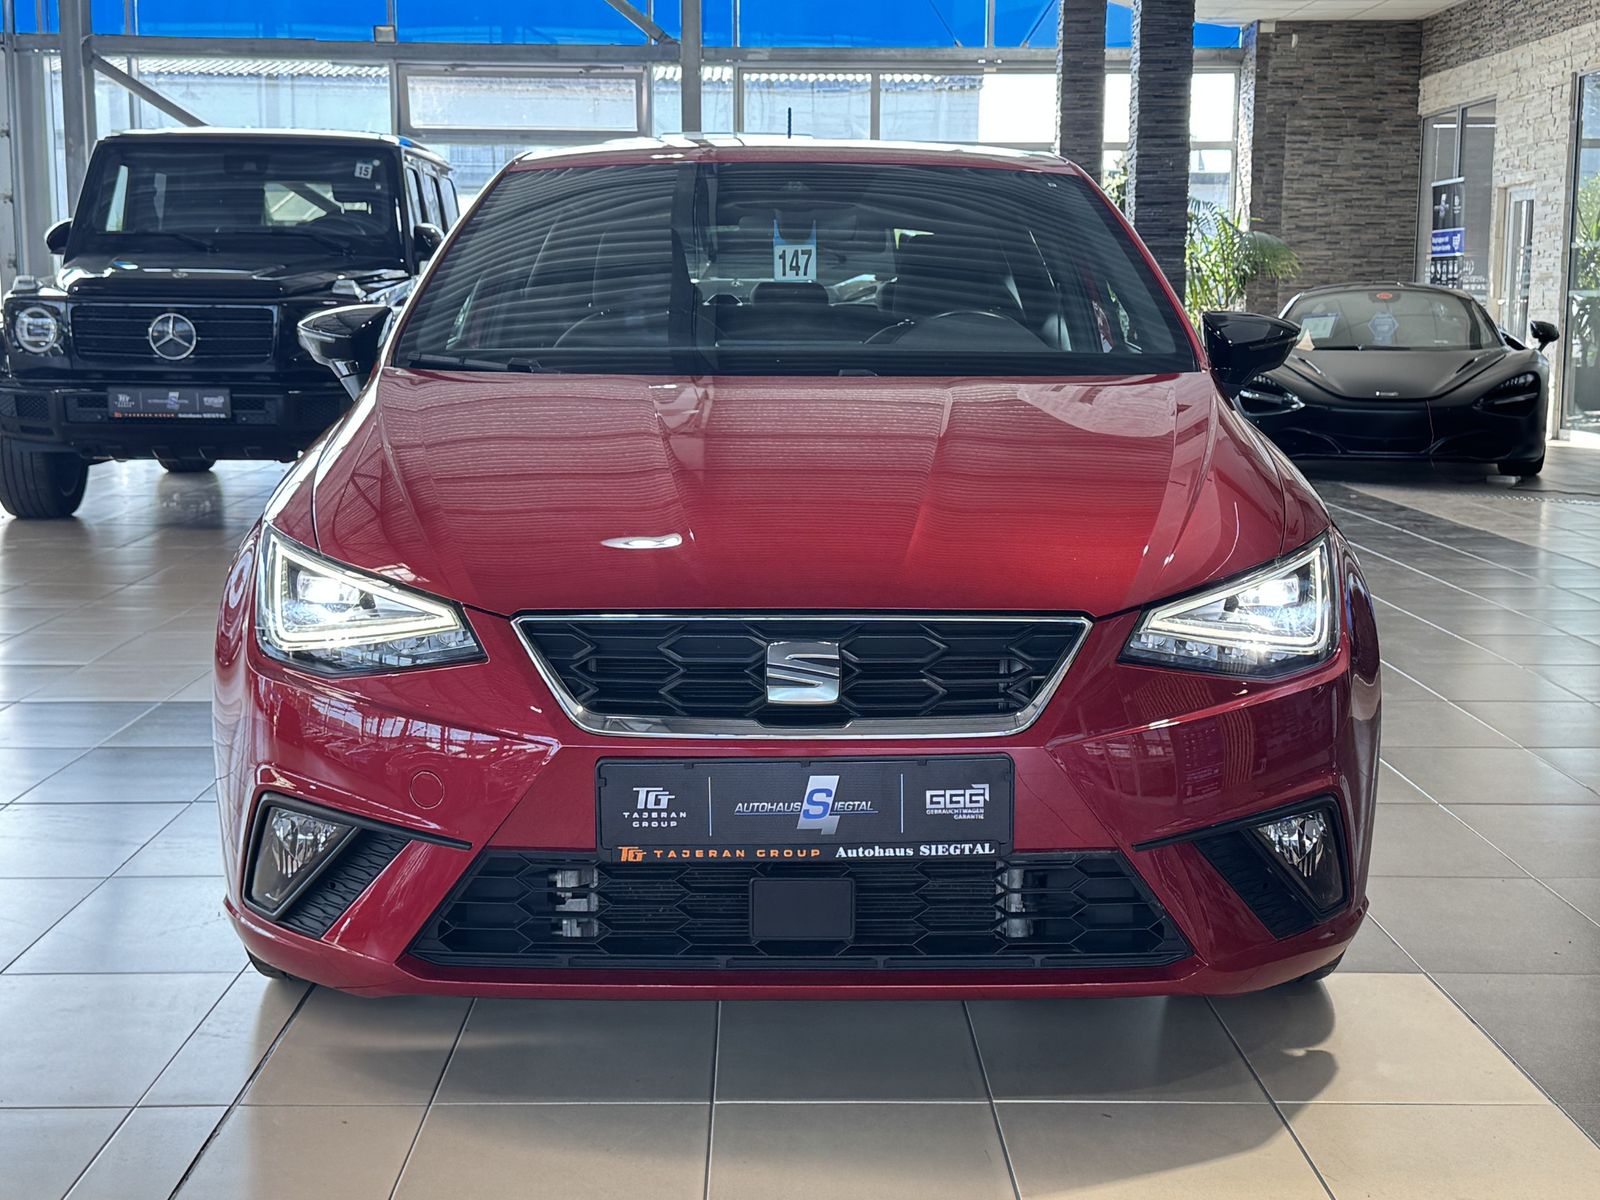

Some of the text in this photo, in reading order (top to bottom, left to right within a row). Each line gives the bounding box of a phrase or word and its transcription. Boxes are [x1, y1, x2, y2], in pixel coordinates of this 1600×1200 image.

[779, 249, 812, 277] 147
[734, 801, 801, 813] AUTOHAUS
[926, 789, 985, 809] GGG
[653, 849, 746, 859] TAJERAN
[756, 849, 821, 858] GROUP
[835, 846, 914, 858] Autohaus
[919, 843, 995, 856] SIEGTAL
